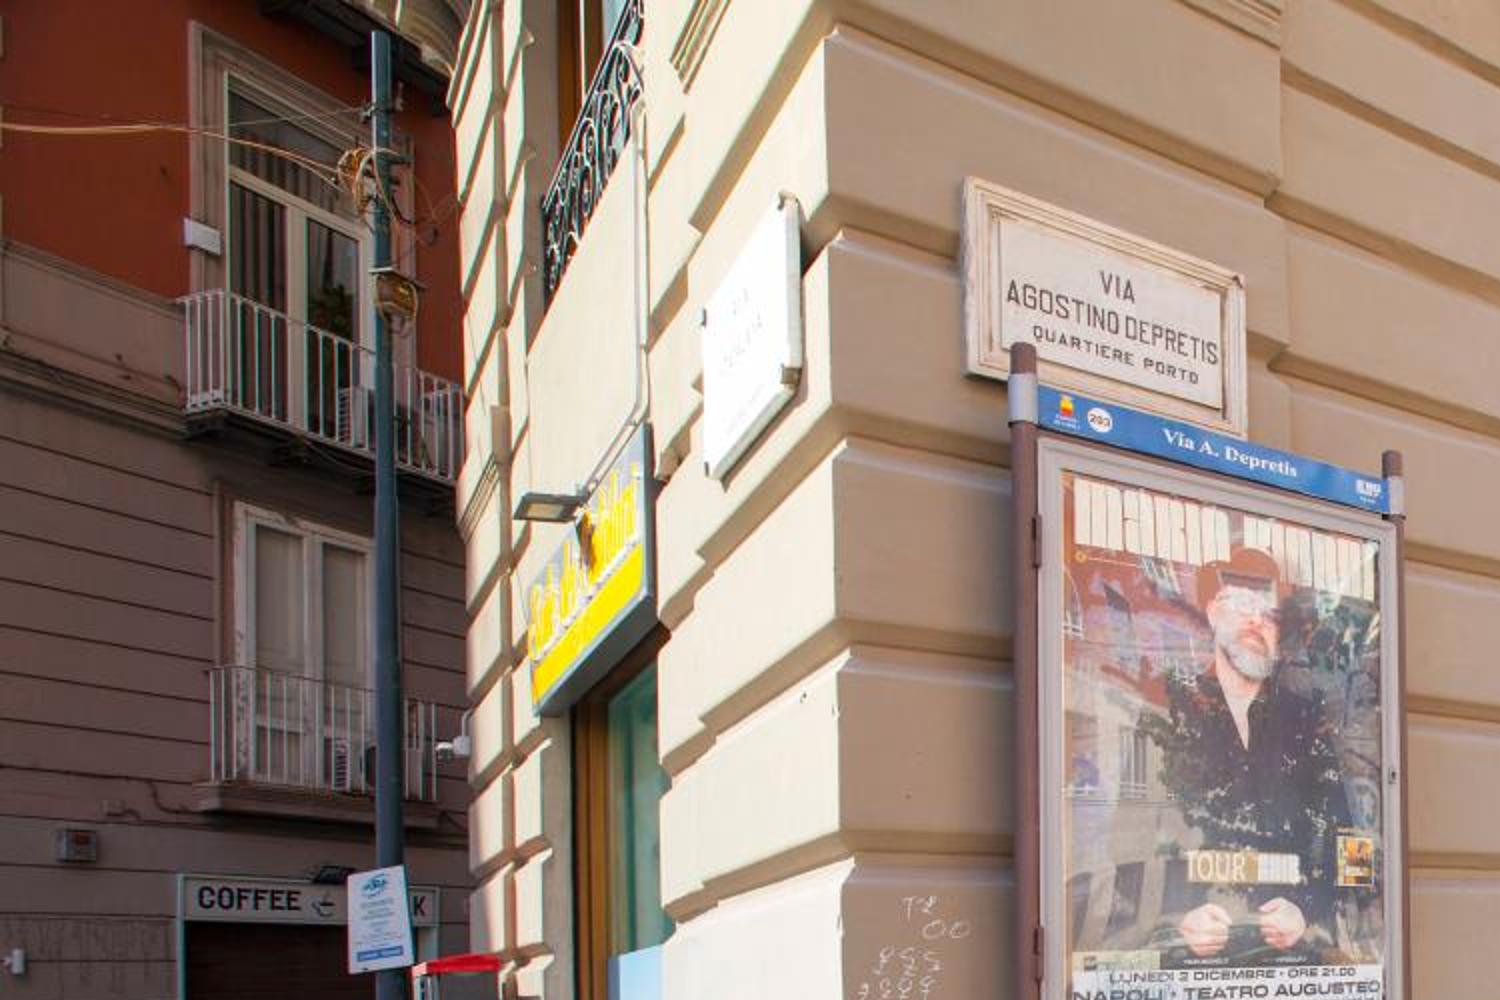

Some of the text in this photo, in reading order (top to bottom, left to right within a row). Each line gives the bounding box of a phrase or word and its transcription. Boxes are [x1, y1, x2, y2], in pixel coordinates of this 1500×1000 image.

[1100, 270, 1135, 304] VIA
[1007, 279, 1219, 366] AGOSTINO DEPRETIS
[1033, 325, 1199, 385] QUARTIERE PORTO
[1163, 428, 1297, 478] Via A. Depretis
[1183, 849, 1248, 882] TOUR
[197, 885, 303, 911] COFFEE
[1184, 985, 1269, 1000] TEATRO
[1274, 980, 1381, 998] AUGUSTEO
[1193, 969, 1276, 982] DICEMBRE
[1287, 967, 1318, 979] ORE
